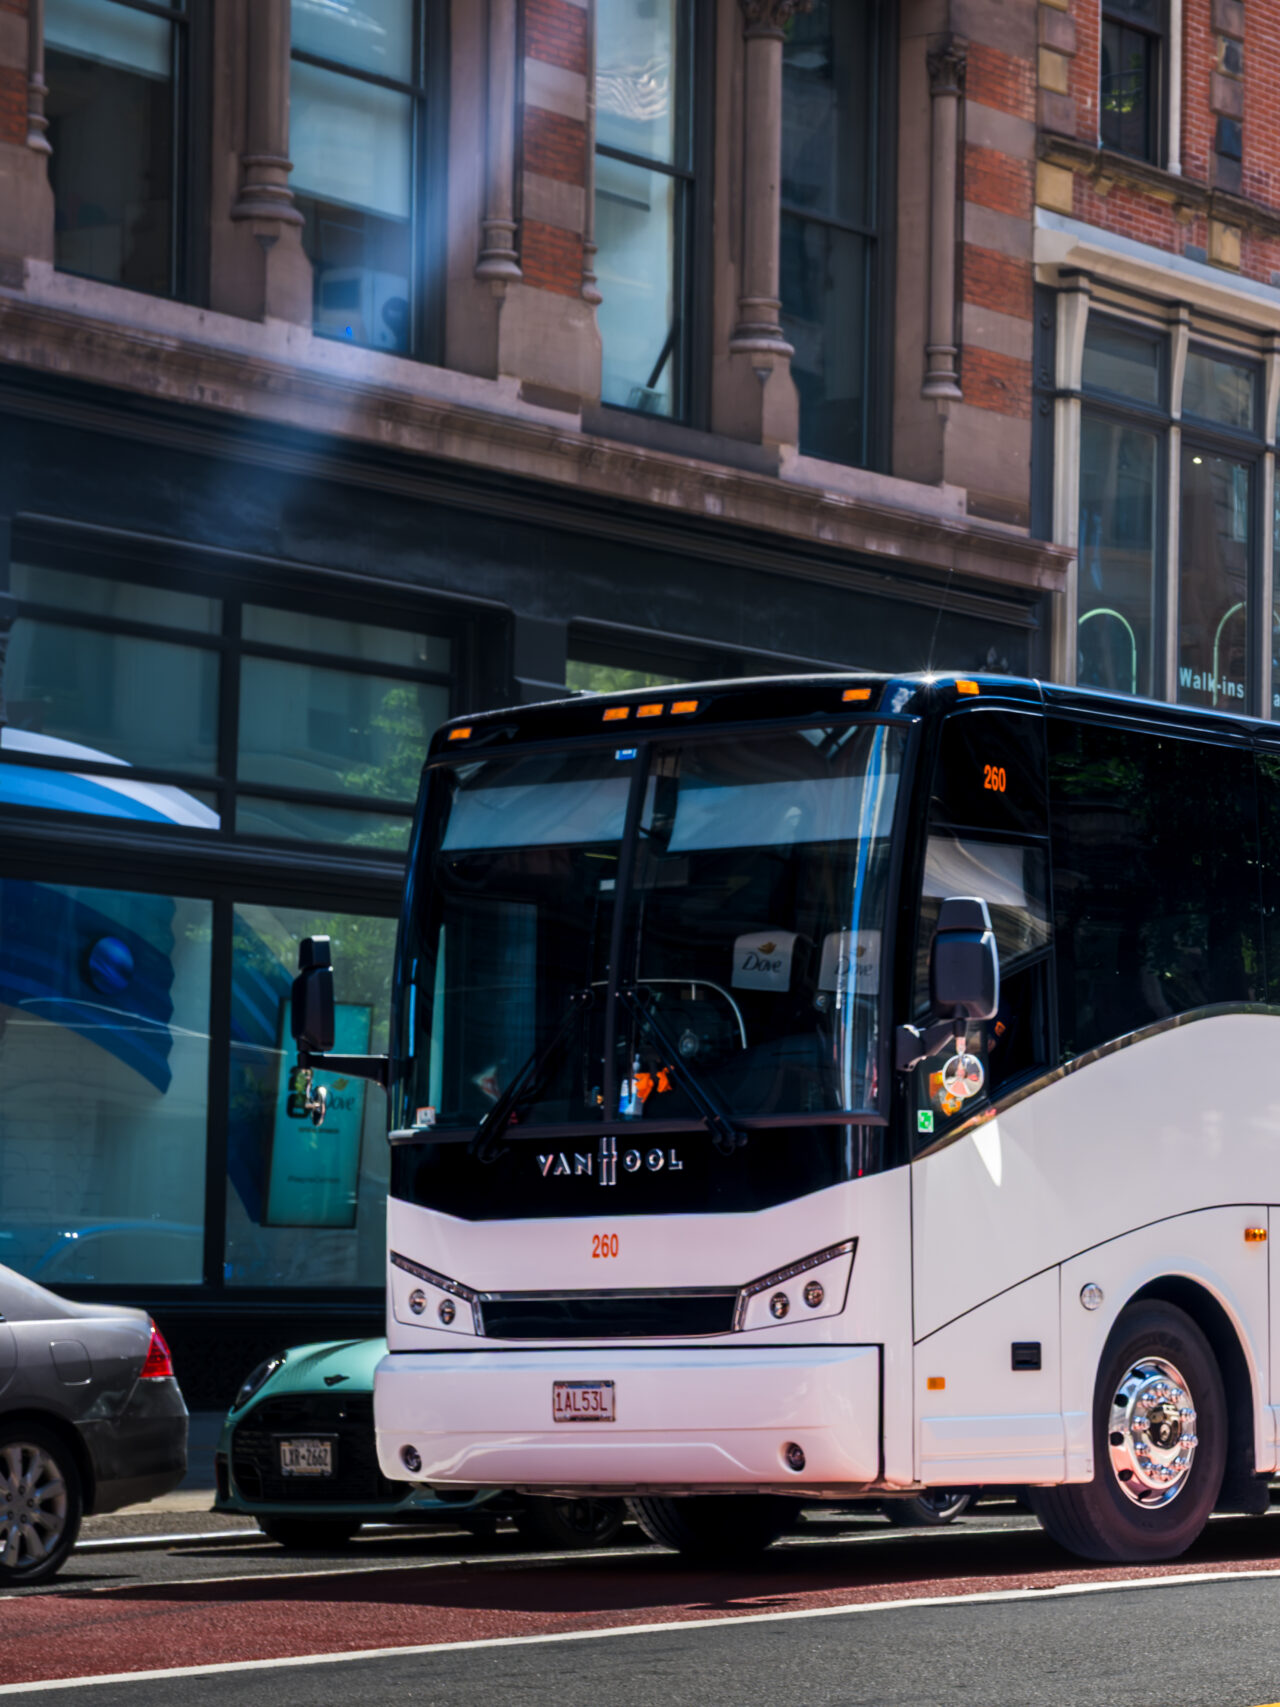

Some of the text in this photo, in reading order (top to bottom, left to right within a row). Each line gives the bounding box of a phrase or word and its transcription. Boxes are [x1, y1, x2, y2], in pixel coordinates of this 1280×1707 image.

[1179, 666, 1245, 699] Walk-ins
[984, 764, 1007, 793] 260
[741, 951, 783, 974] Dove
[591, 1233, 620, 1260] 260
[556, 1390, 609, 1412] 1AL53L
